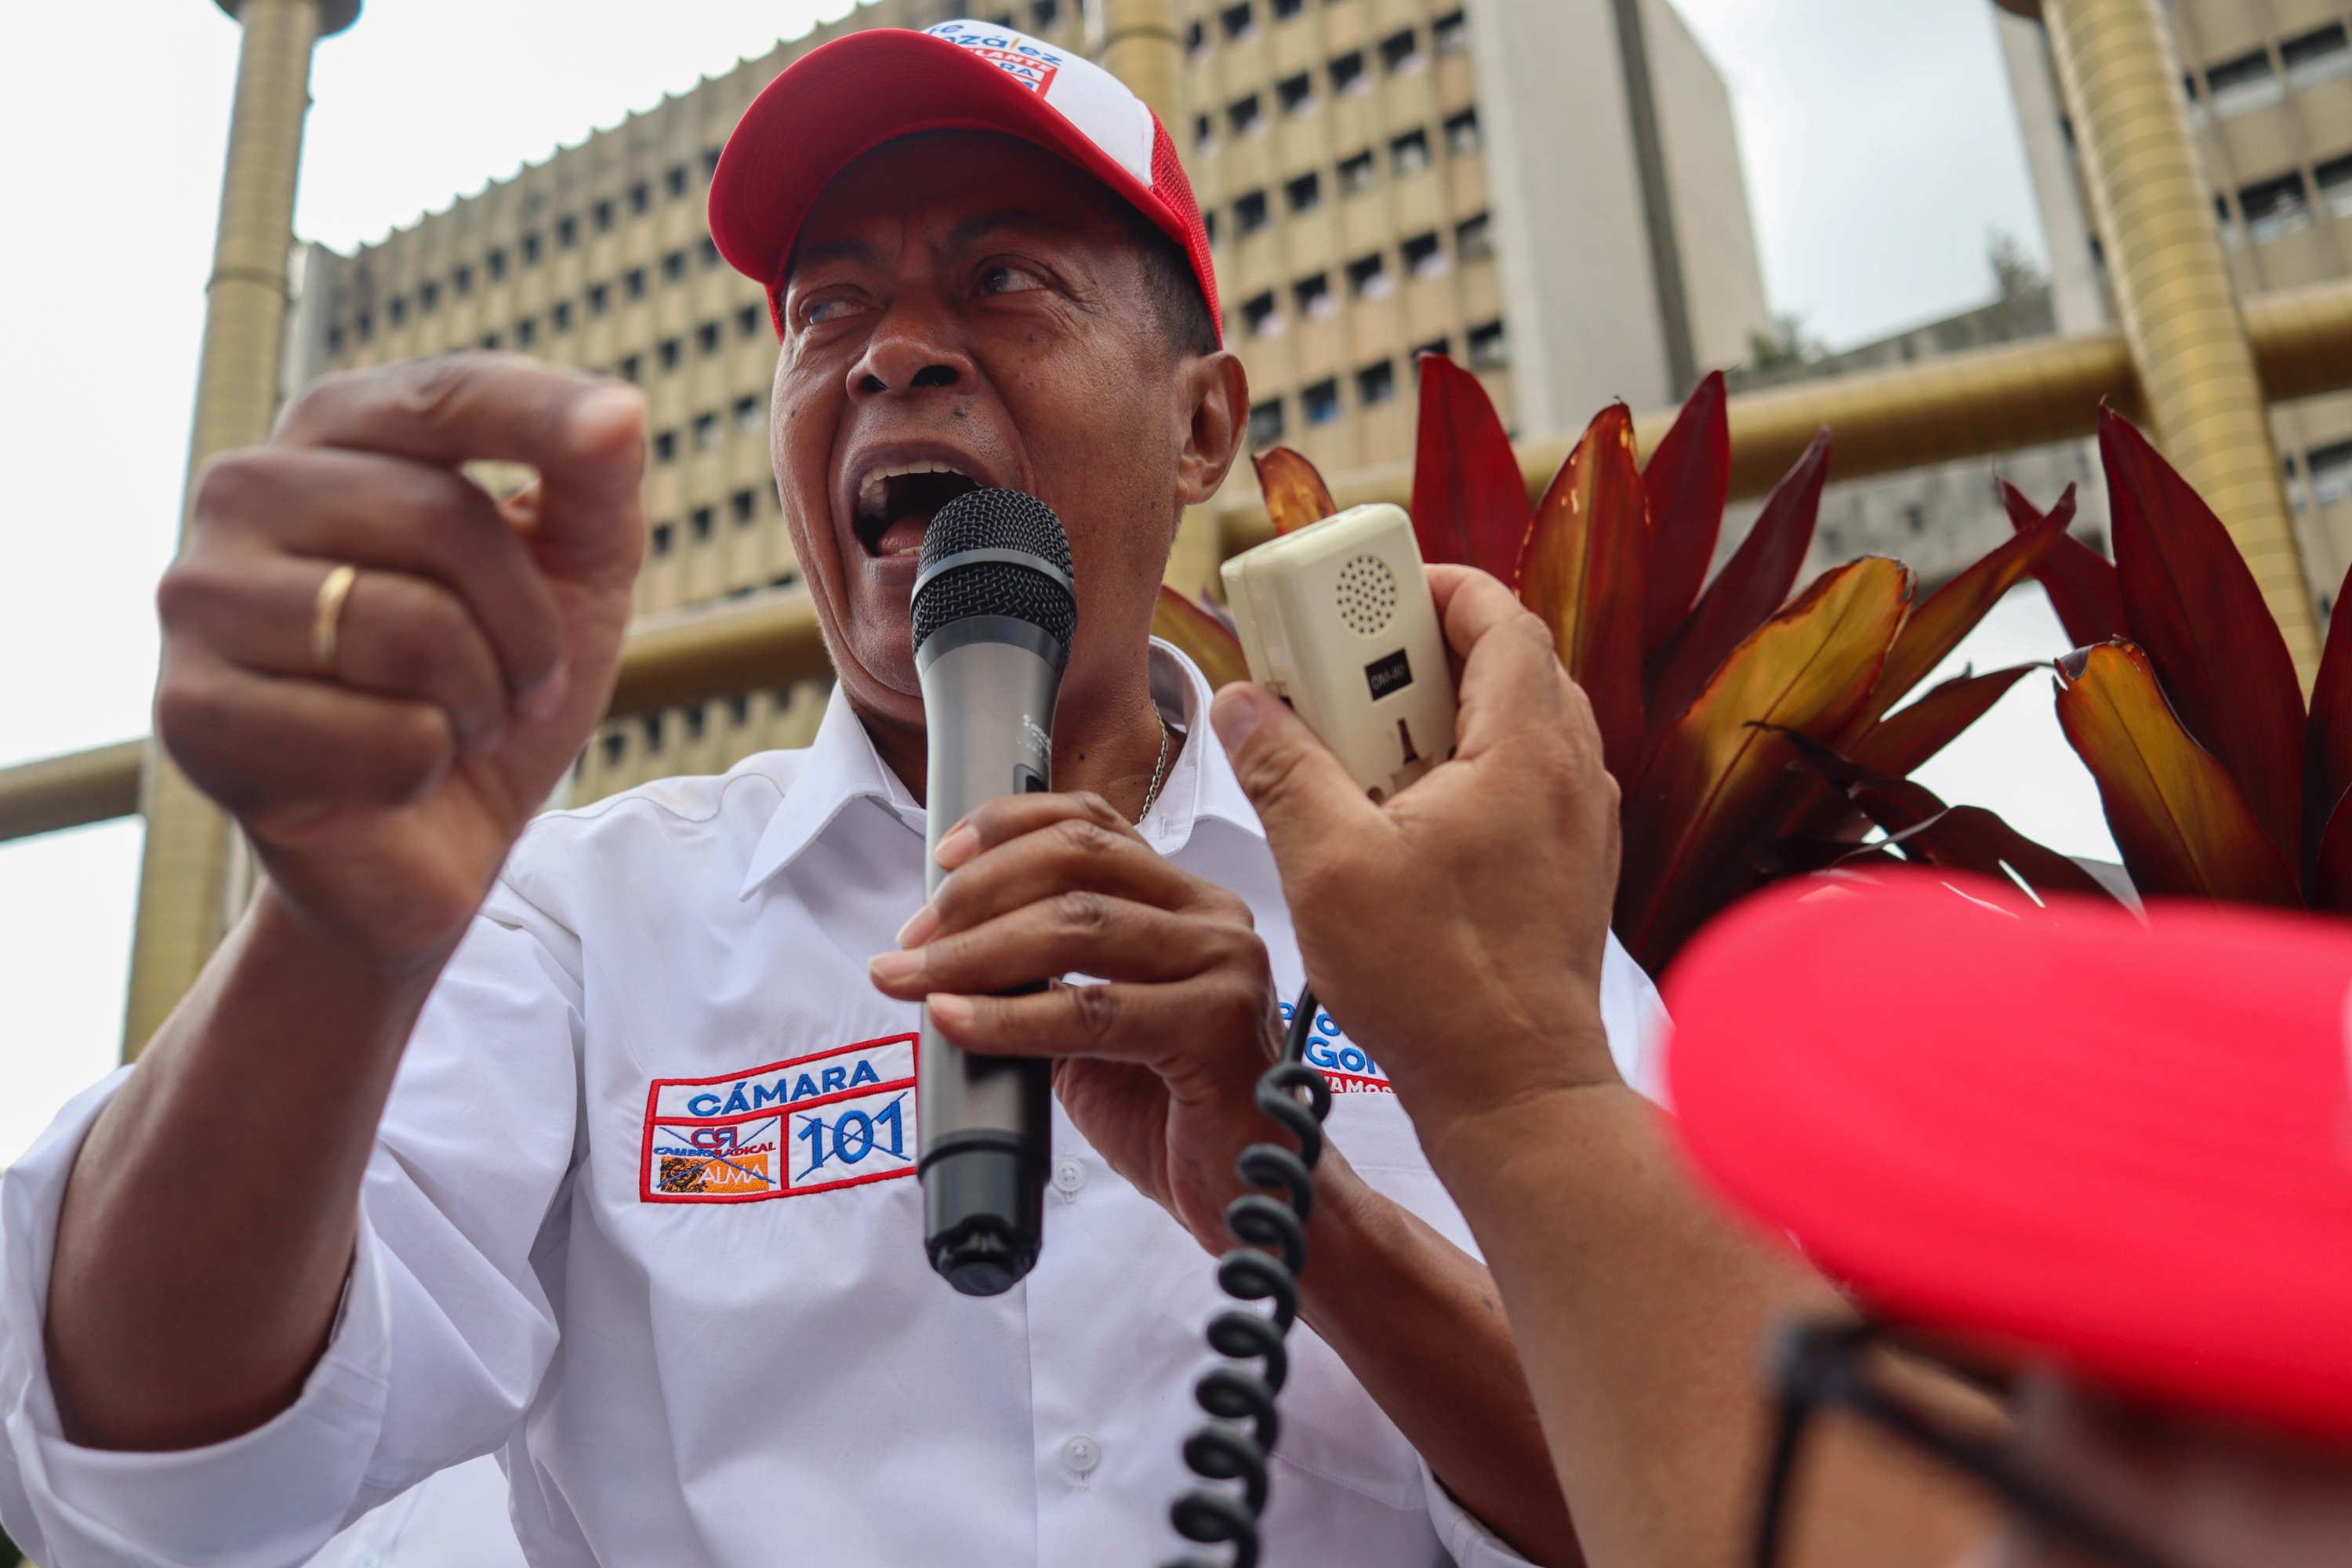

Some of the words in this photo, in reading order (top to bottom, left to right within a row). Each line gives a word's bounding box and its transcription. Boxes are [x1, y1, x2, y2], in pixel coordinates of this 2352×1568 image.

[969, 49, 1054, 72] LANTE
[993, 61, 1034, 78] RA
[687, 1060, 880, 1117] CÁMARA
[797, 1100, 903, 1168] 101
[697, 1163, 767, 1185] ALMA
